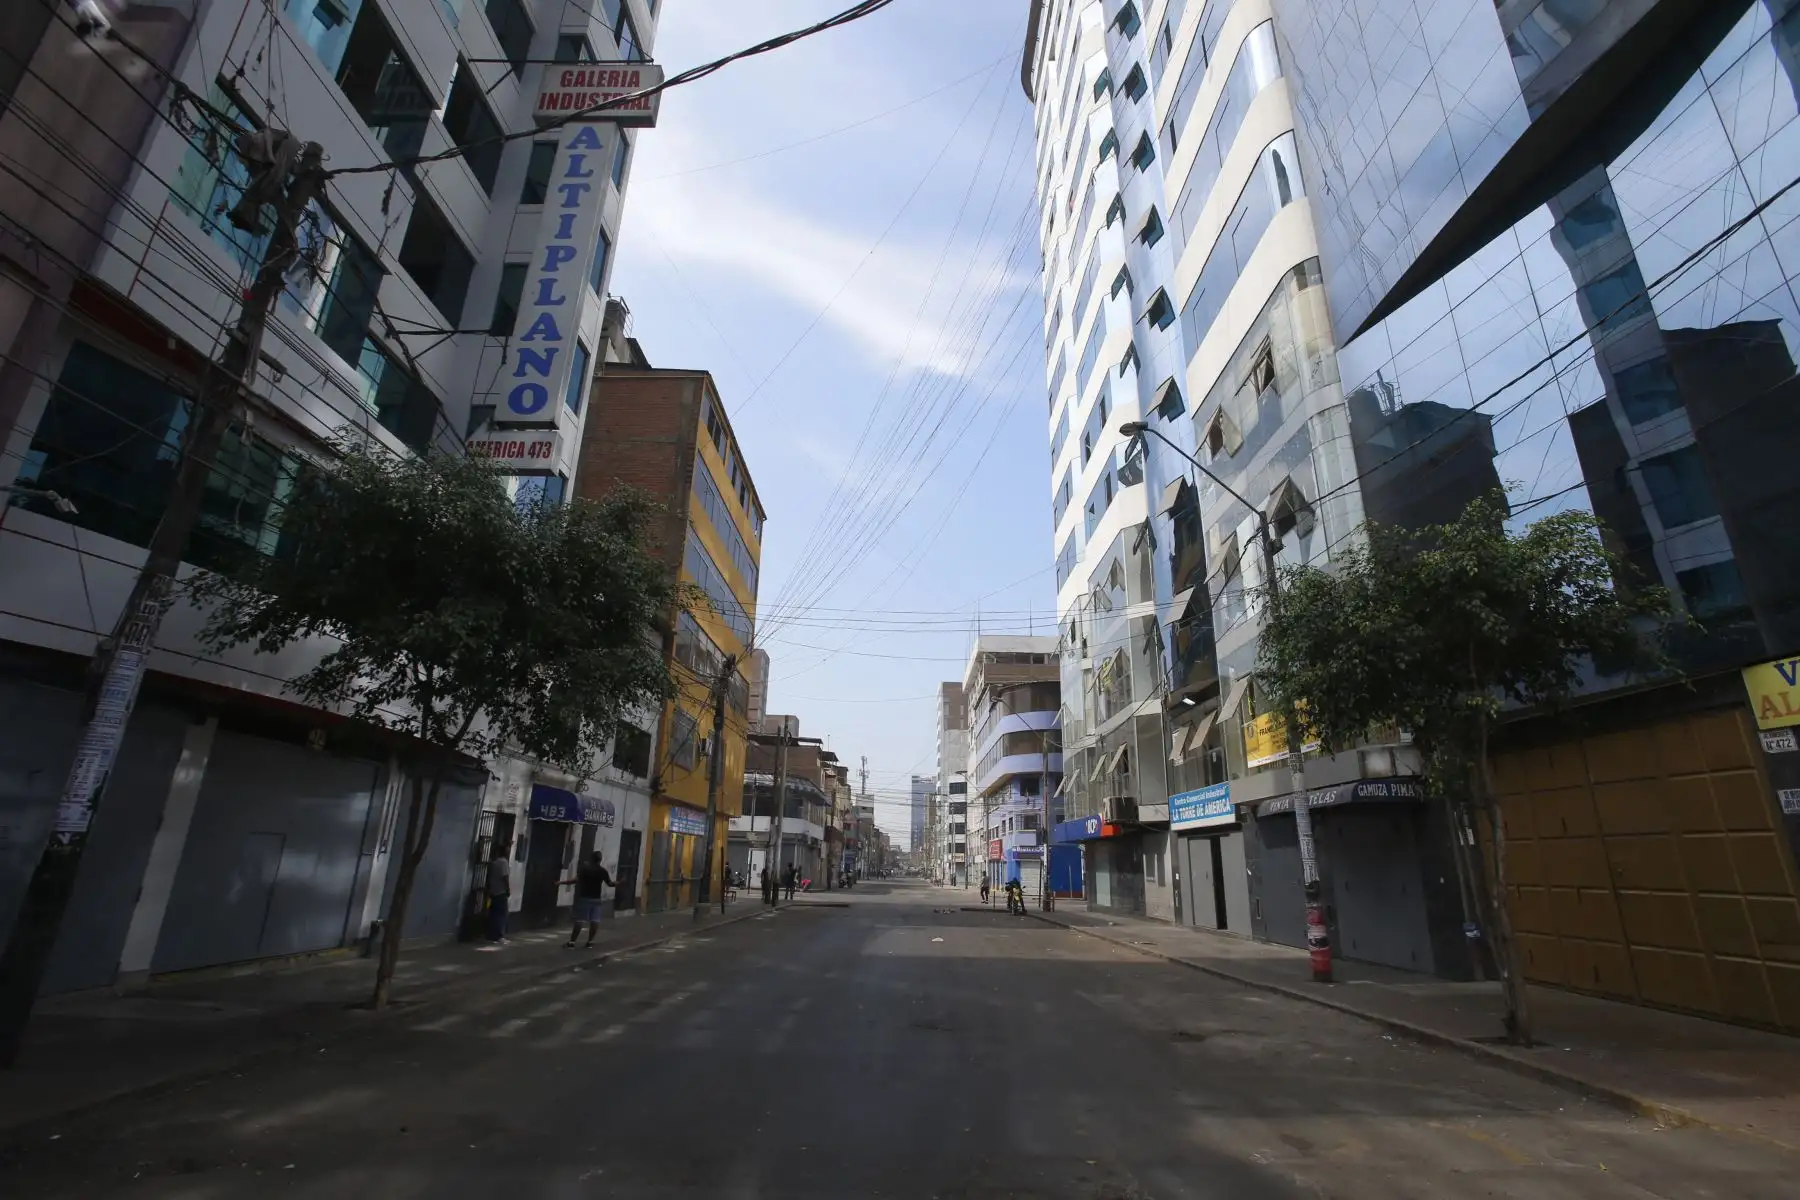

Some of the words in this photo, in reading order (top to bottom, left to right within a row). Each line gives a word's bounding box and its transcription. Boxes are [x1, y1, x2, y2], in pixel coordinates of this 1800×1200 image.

[560, 70, 640, 87] GALERIA
[507, 125, 603, 415] ALTIPLANO
[528, 441, 552, 459] 473
[1774, 660, 1800, 687] V
[1759, 691, 1800, 720] AL
[1308, 790, 1337, 805] TELAS
[1357, 783, 1388, 797] GAMUZA
[1391, 783, 1415, 797] PIMA
[540, 804, 566, 818] 483
[1172, 807, 1180, 821] LA
[1179, 805, 1196, 820] TORRE
[1196, 803, 1204, 817] DE
[1204, 797, 1231, 815] AMERICA
